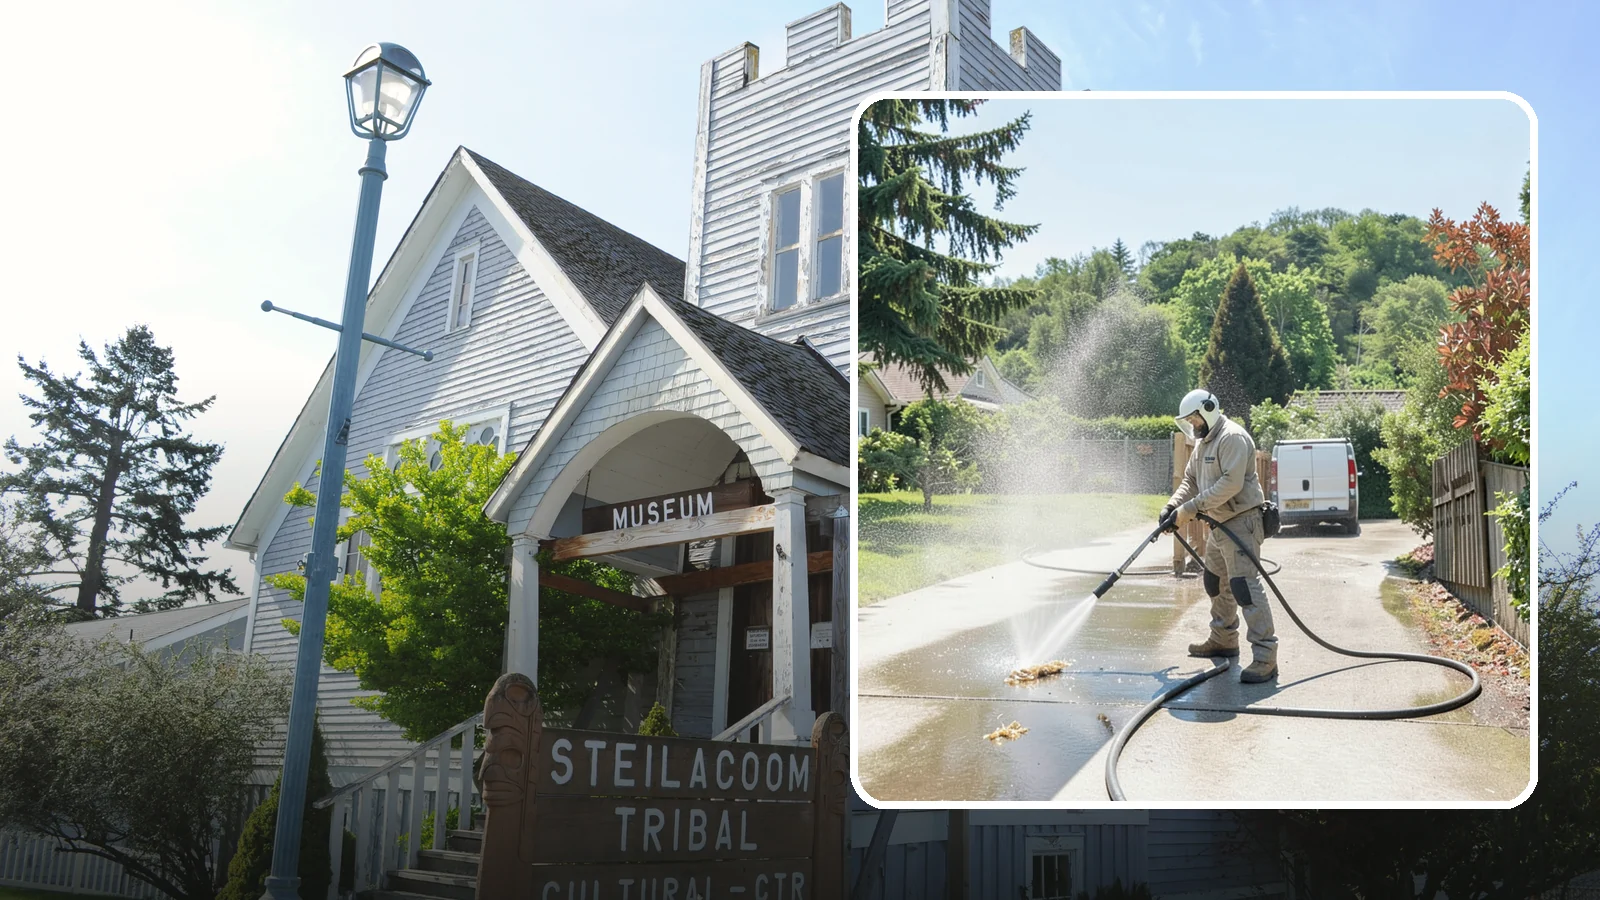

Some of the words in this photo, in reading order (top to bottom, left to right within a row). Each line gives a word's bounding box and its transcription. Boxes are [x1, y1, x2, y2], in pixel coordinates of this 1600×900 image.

[612, 491, 714, 531] MUSEUM
[550, 737, 810, 793] STEILACOOM
[614, 806, 758, 852] TRIBAL
